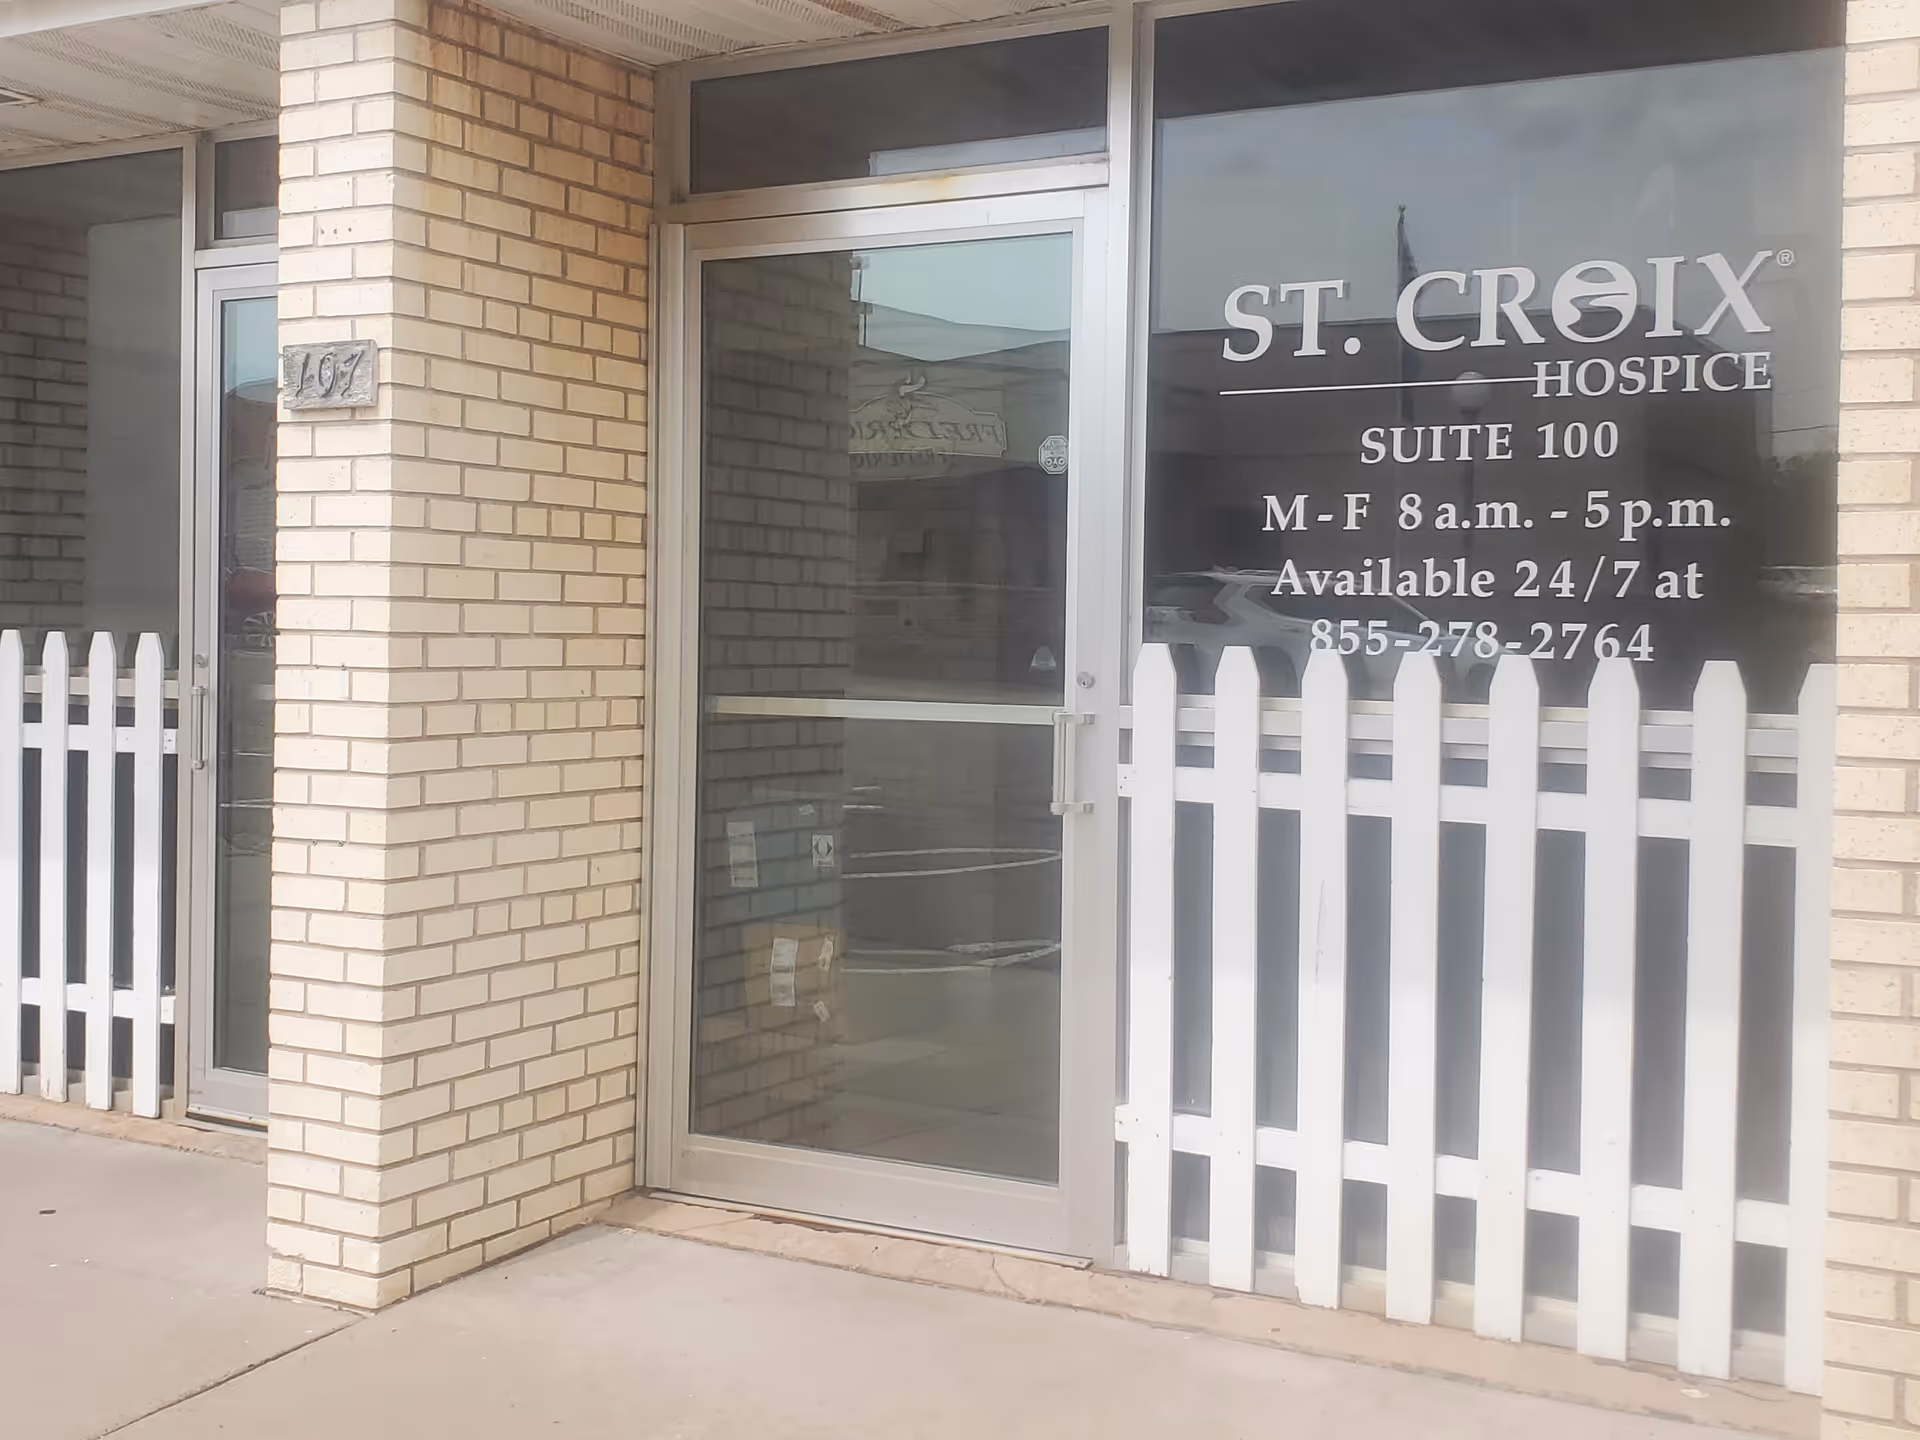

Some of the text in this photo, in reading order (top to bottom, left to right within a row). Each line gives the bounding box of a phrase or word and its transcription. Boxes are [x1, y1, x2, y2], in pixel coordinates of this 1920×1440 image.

[1222, 279, 1362, 362] ST.
[1396, 250, 1773, 352] CROIX
[295, 350, 365, 398] 107
[1532, 351, 1772, 398] HOSPICE
[1360, 421, 1619, 464] SUITE 100
[1270, 555, 1704, 603] Available 24/7 at
[1310, 618, 1655, 662] 855-278-2764
